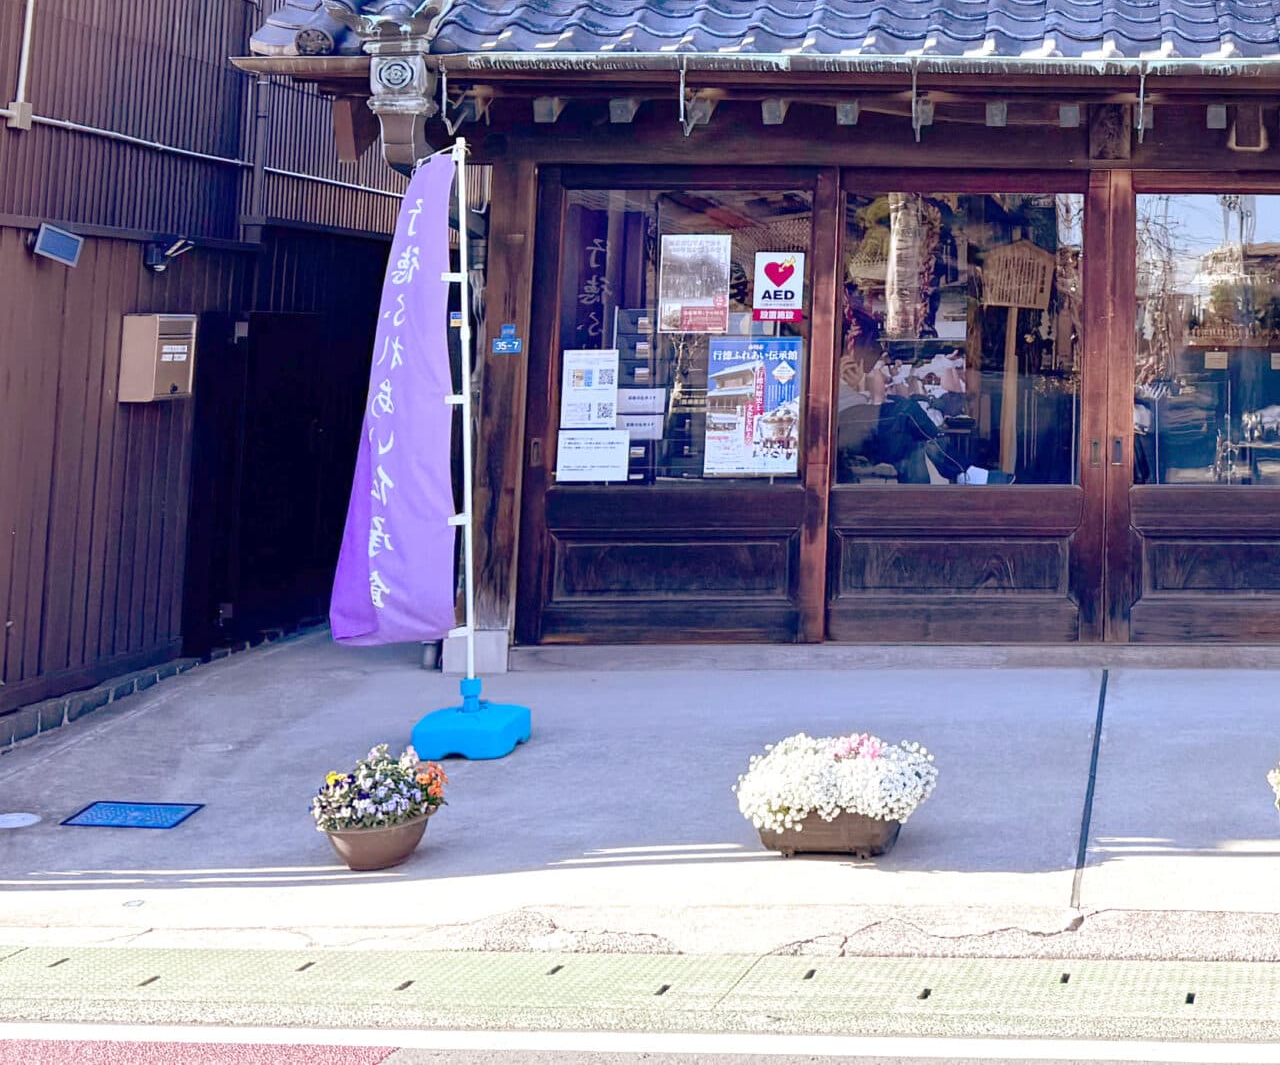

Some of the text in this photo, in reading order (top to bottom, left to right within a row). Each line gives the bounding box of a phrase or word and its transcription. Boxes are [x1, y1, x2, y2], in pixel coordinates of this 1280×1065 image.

[761, 289, 795, 300] AED
[495, 341, 519, 351] 35-7
[712, 350, 798, 361] 行徳ふれあい伝承館
